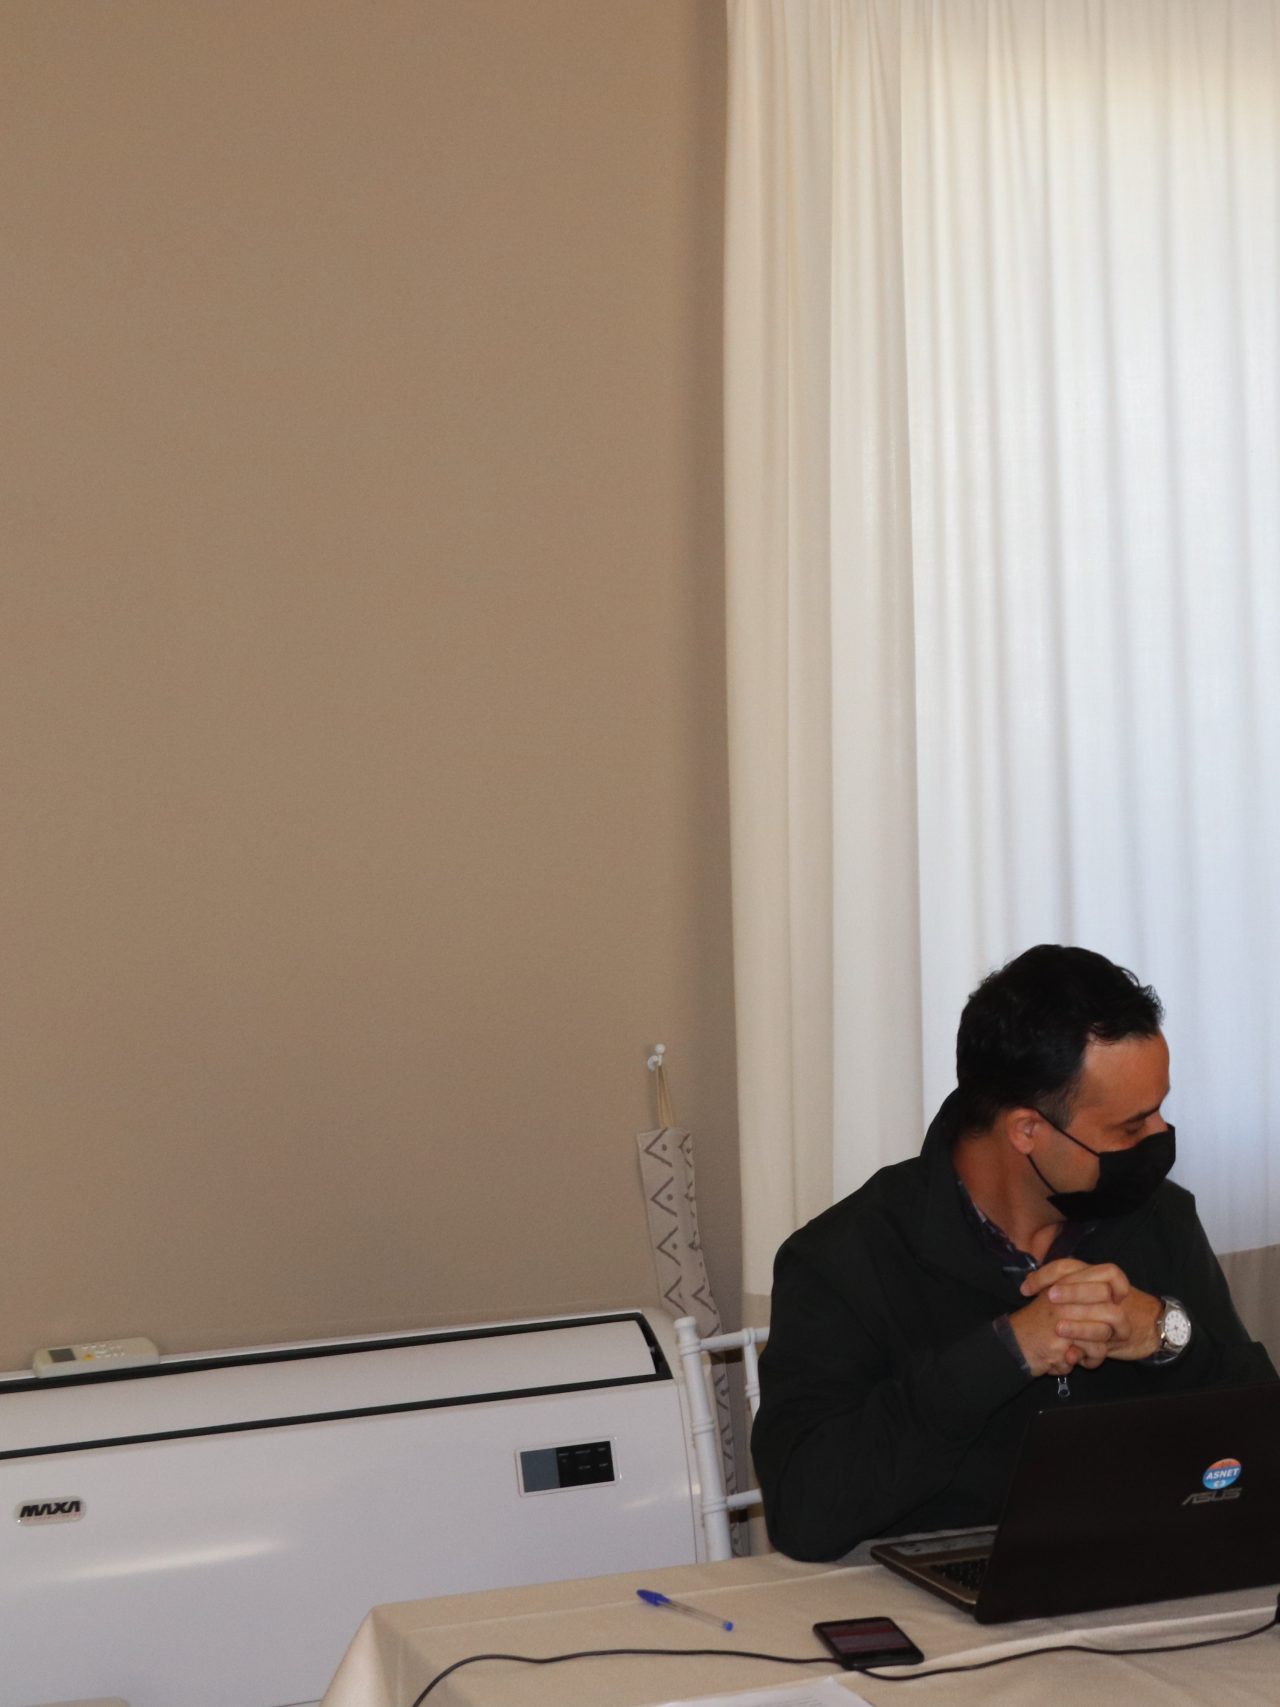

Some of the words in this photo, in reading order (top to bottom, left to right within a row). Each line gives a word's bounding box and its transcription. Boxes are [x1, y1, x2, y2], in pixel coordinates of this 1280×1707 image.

[1206, 1468, 1240, 1480] ASNET
[1181, 1487, 1242, 1506] ASUS
[20, 1501, 81, 1518] MAXA
